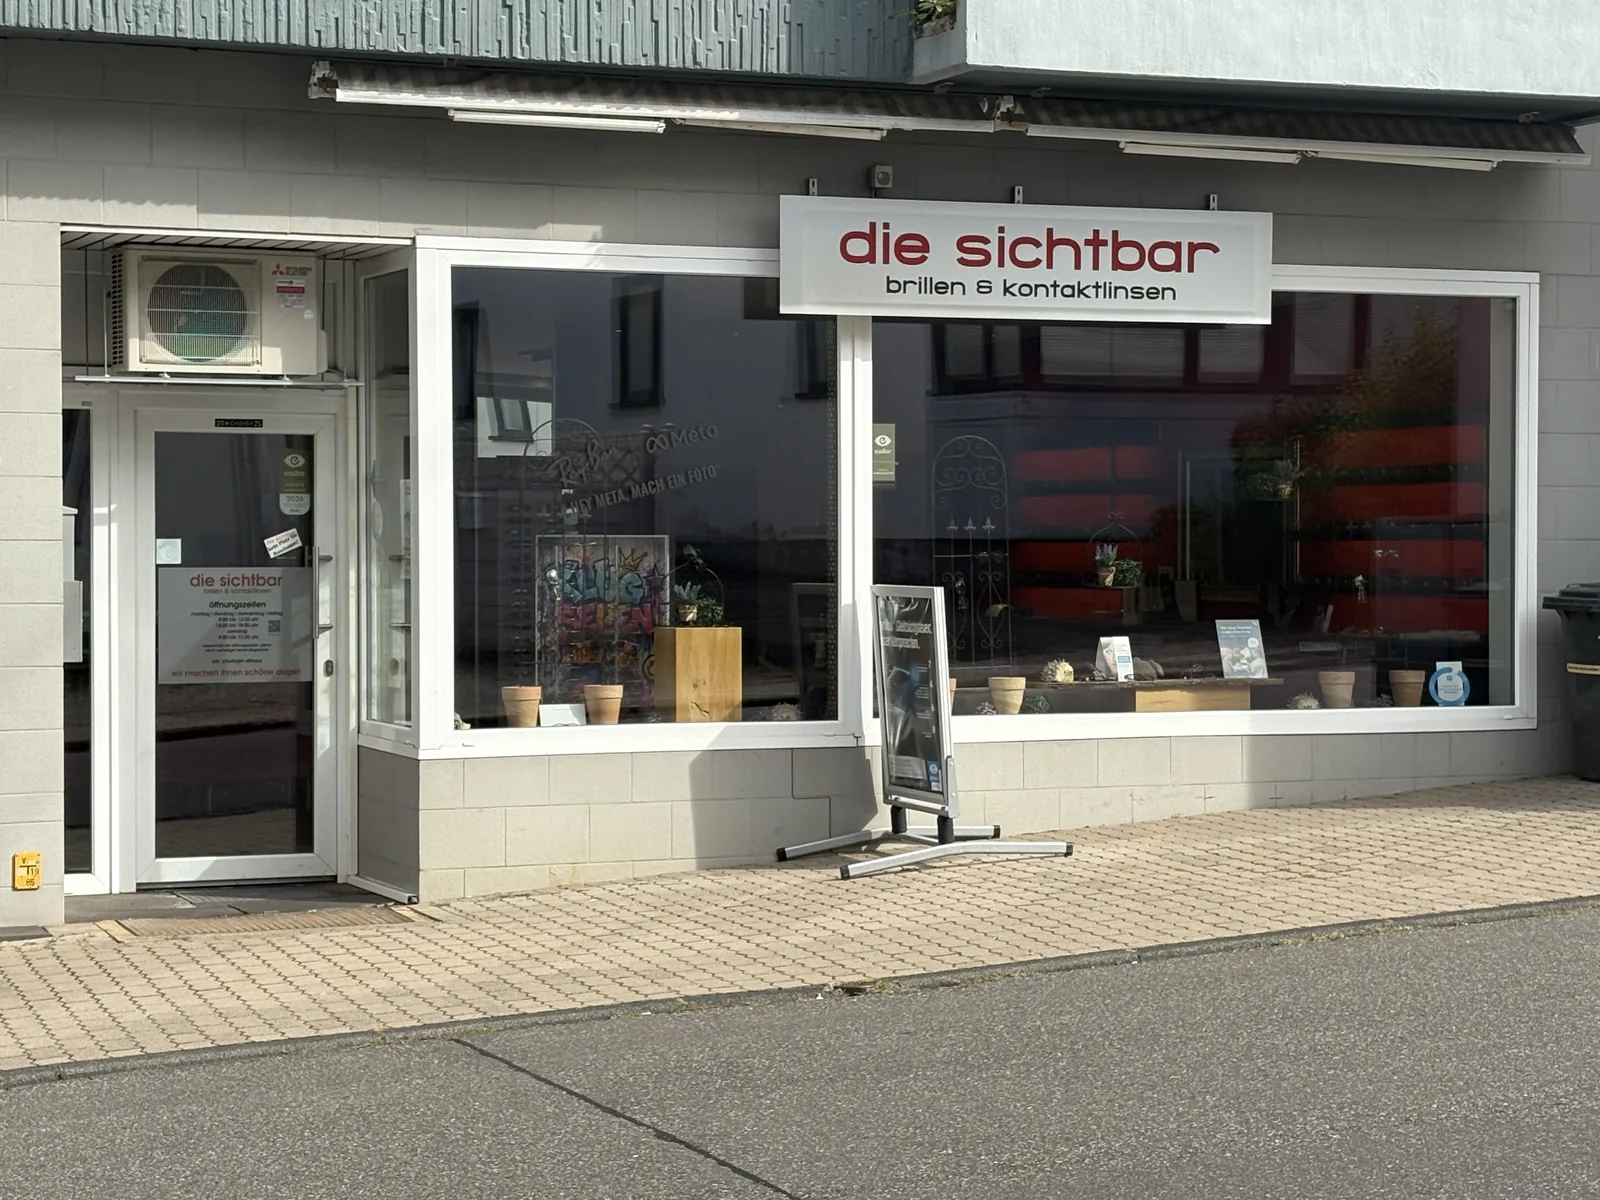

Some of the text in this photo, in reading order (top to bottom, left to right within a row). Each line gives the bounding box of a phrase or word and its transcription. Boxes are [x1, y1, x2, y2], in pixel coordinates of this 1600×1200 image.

[840, 222, 1220, 273] die sichtbar
[885, 275, 1176, 300] brillen & kontaktlinsen
[670, 425, 718, 448] Meta
[595, 488, 630, 510] META,
[630, 480, 665, 499] MACH
[666, 472, 686, 489] EIN
[190, 573, 283, 587] die sichtbar
[209, 601, 267, 609] öffnungszeiten
[171, 667, 302, 677] wir machen ihnen schöne augen
